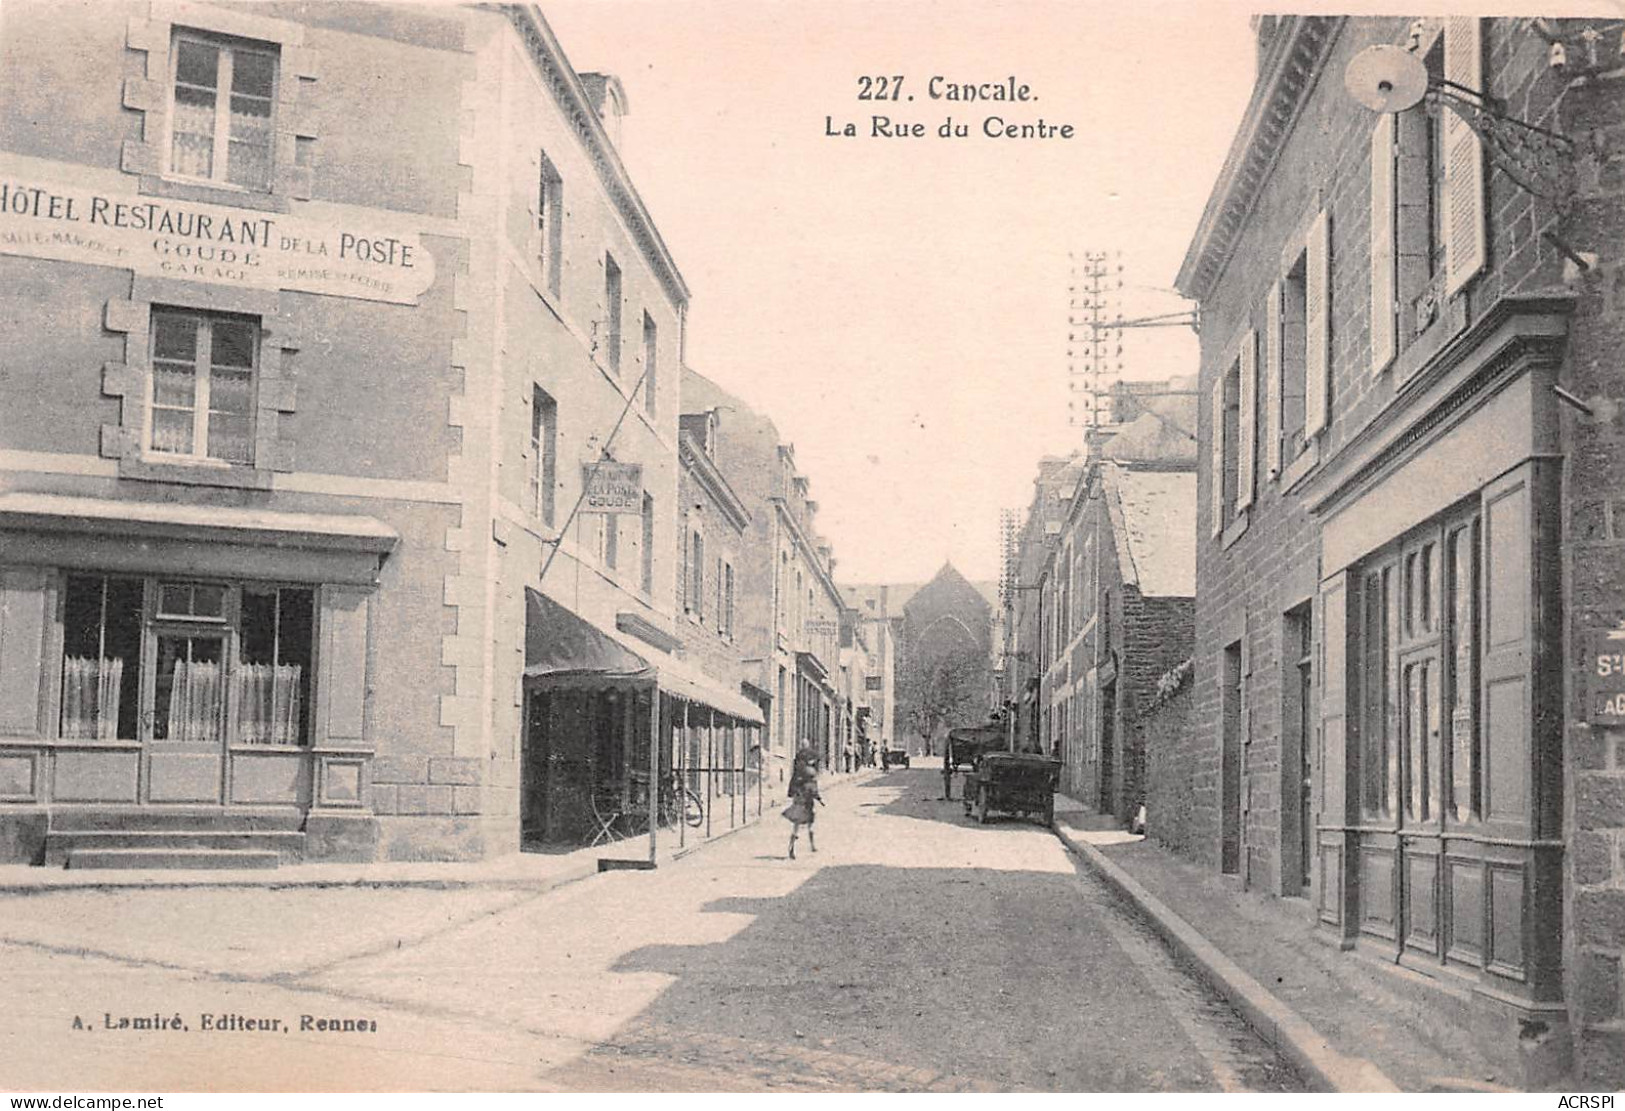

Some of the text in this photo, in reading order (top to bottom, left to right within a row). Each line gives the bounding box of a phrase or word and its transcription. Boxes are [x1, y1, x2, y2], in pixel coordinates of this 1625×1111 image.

[90, 196, 276, 248] RESTAURANT
[280, 236, 299, 251] DE
[306, 240, 329, 256] LA
[340, 232, 415, 268] POSTE
[589, 496, 633, 507] GOUDE
